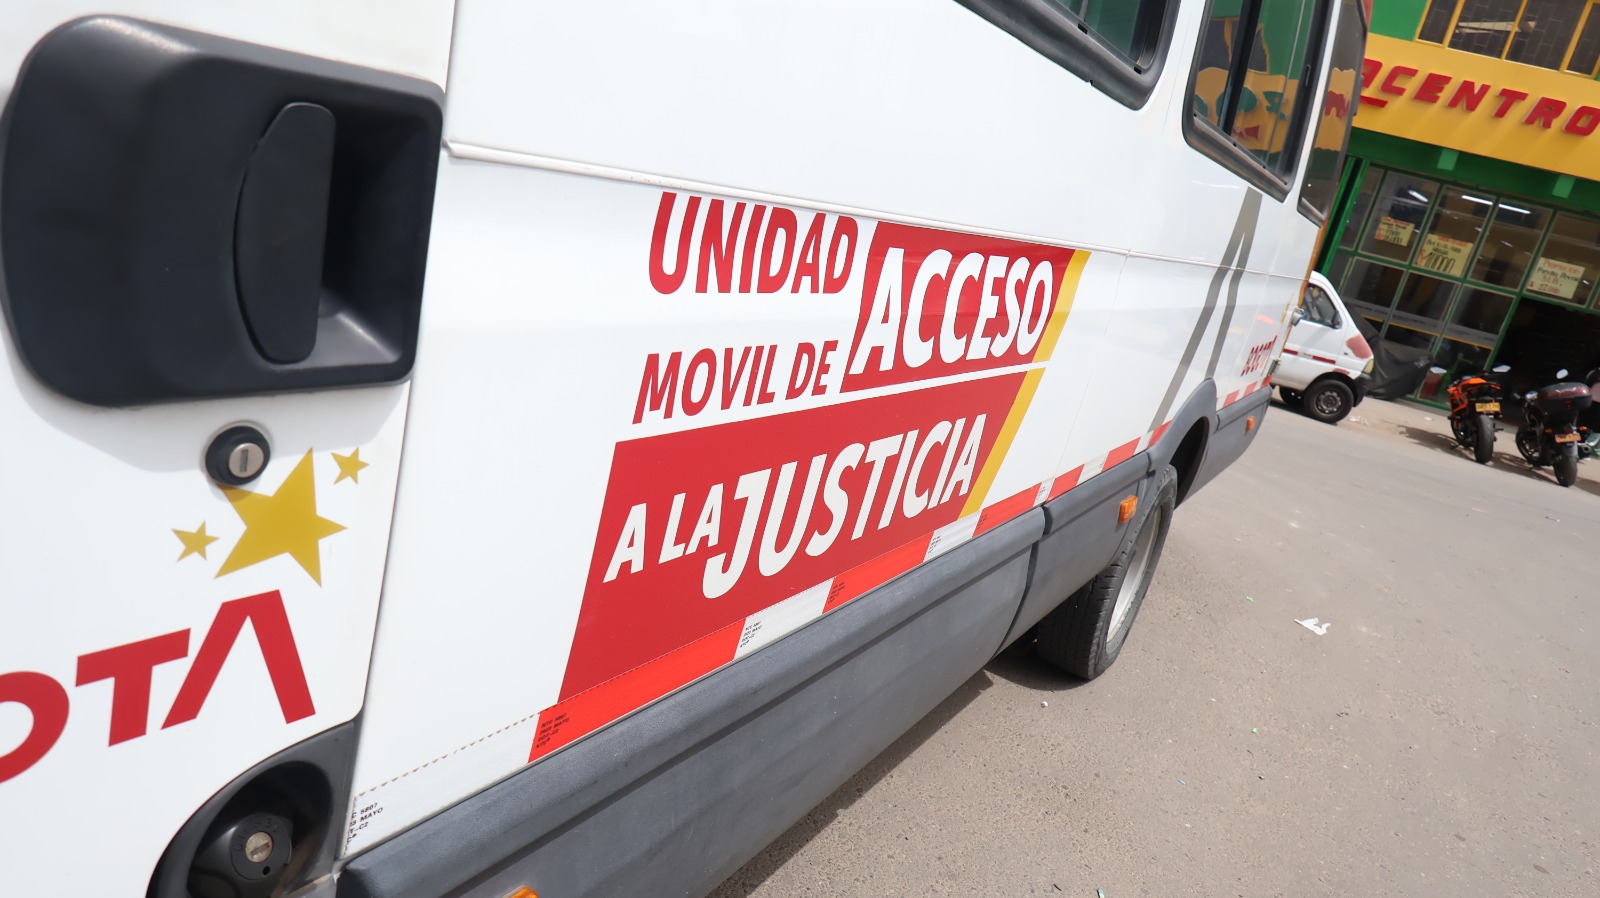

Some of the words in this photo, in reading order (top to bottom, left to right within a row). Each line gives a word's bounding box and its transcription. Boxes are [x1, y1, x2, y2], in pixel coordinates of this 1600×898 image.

[648, 192, 858, 295] UNIDAD
[849, 247, 1054, 376] ACCESO
[632, 344, 778, 425] MOVIL
[785, 340, 839, 401] DE
[602, 502, 647, 584] A
[658, 482, 725, 565] LA
[702, 413, 988, 600] JUSTICIA
[360, 807, 384, 822] MAYO
